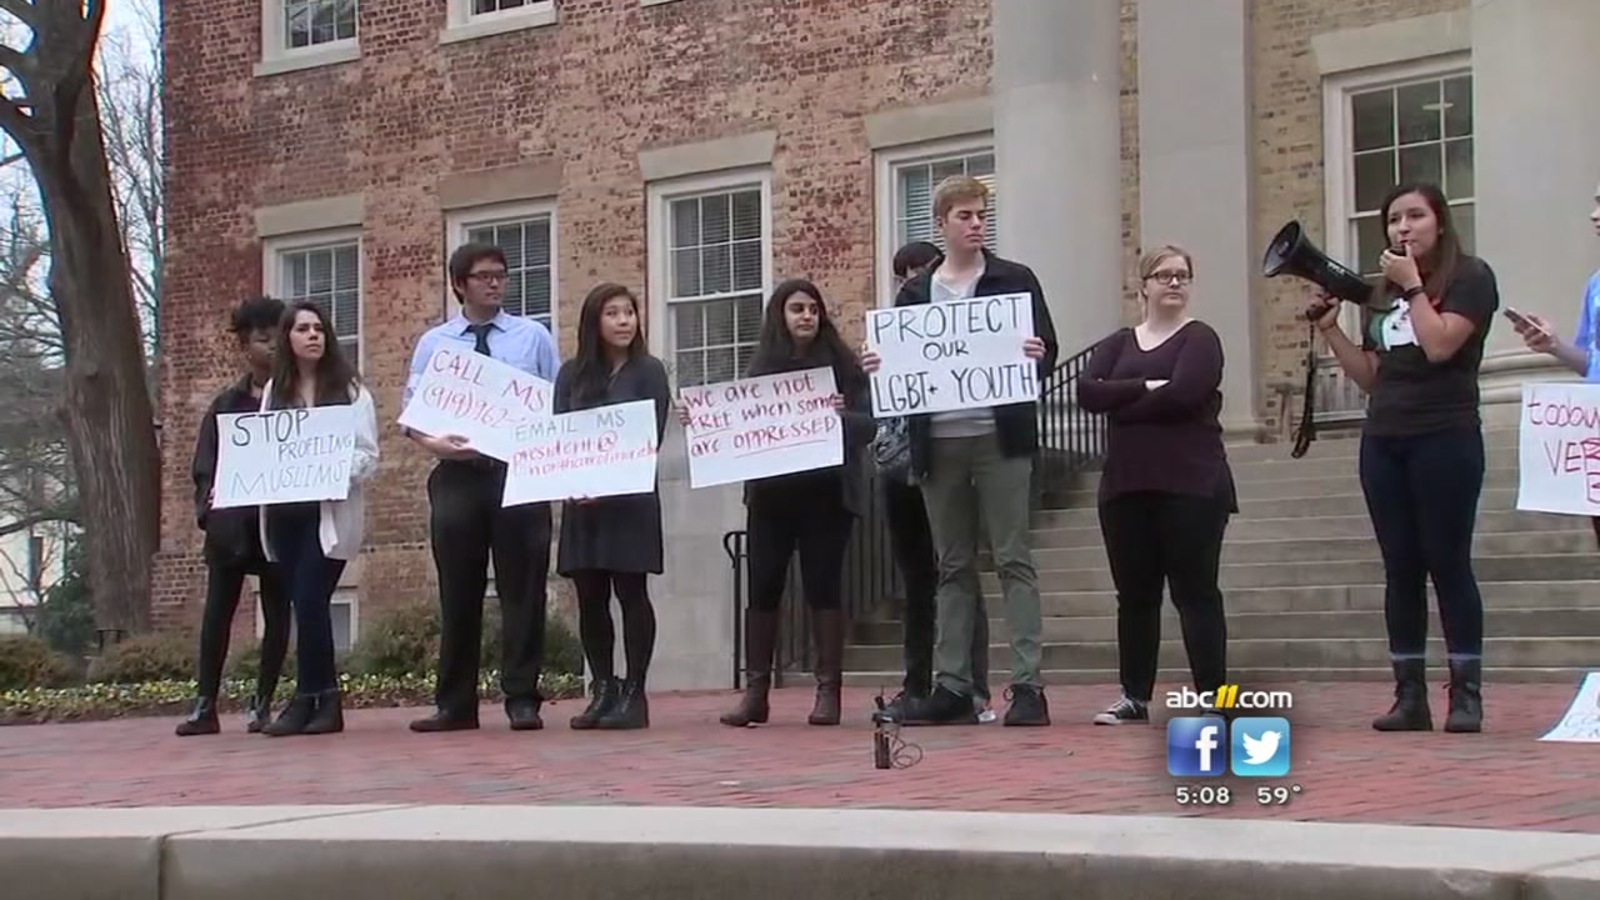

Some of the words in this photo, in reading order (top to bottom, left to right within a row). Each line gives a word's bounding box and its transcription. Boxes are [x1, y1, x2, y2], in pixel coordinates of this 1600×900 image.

[873, 297, 1022, 344] PROTECT
[923, 340, 969, 361] OUR
[433, 350, 484, 386] CALL
[501, 379, 544, 412] MS
[724, 383, 761, 402] are
[773, 372, 815, 395] not
[873, 371, 938, 412] LGBT+
[951, 362, 1034, 402] YOUTH
[422, 382, 528, 428] (919)962-
[690, 412, 732, 434] FREE
[741, 402, 791, 421] when
[232, 409, 309, 446] STOP
[515, 417, 577, 441] EMAIL
[596, 409, 626, 428] MS
[691, 439, 719, 457] are
[734, 416, 836, 450] OPPRESSED
[279, 434, 352, 462] PROFILING
[231, 460, 346, 498] MUSLIMS
